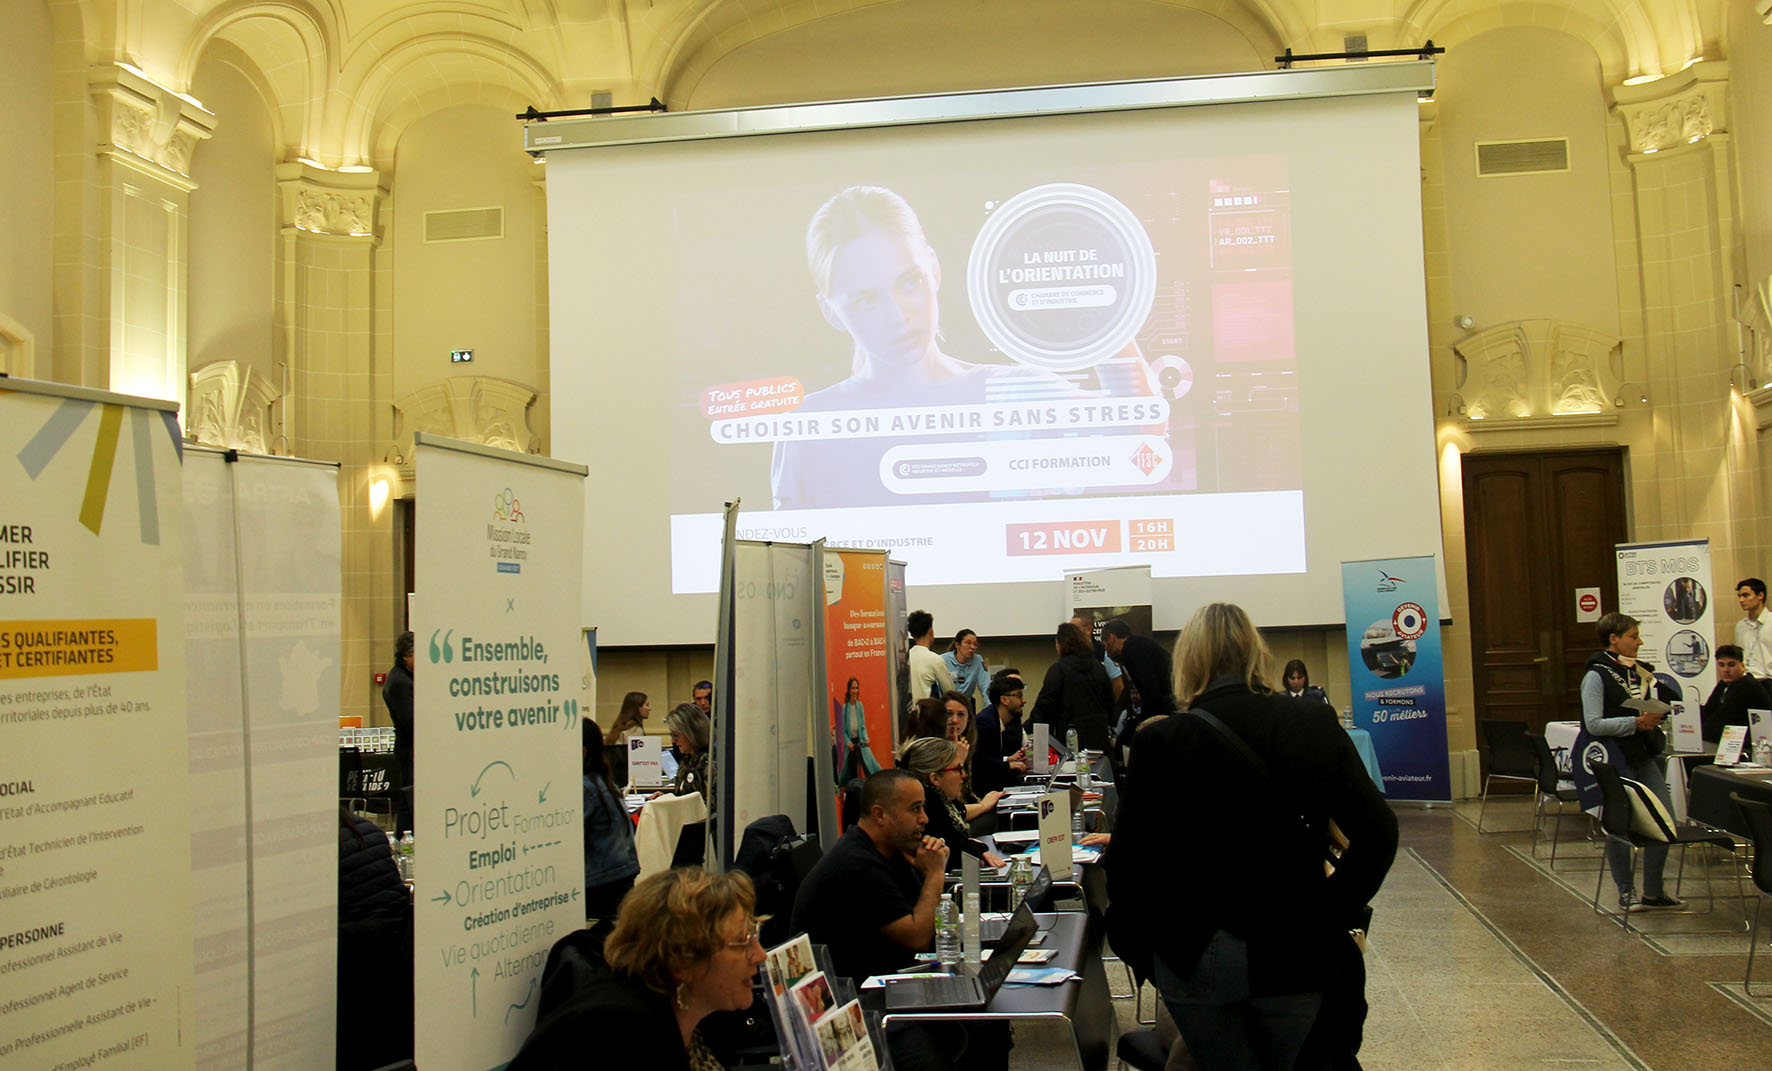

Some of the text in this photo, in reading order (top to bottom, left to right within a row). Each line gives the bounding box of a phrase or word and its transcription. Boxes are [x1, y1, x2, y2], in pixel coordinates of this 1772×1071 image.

[1023, 249, 1097, 265] LA NUIT DE
[999, 263, 1125, 285] L'ORIENTATION
[708, 382, 798, 403] TOUS PUBLICS
[707, 395, 801, 415] ENTRÉE GRATUITE
[720, 403, 1162, 440] CHOISIR SON AVENIR SANS STRESS
[1009, 455, 1111, 470] CCI FORMATION
[1018, 527, 1108, 550] 12 NOV
[1136, 522, 1169, 534] 16H
[851, 539, 863, 549] ET
[865, 537, 934, 548] D'INDUSTRIE
[1137, 538, 1169, 551] 20H
[1625, 556, 1699, 577] BTS MOS
[1397, 602, 1421, 613] DEVENIR
[0, 630, 119, 650] S QUALIFIANTES,
[1397, 628, 1424, 640] AVIATEUR
[16, 649, 114, 668] CERTIFIANTES
[461, 635, 548, 664] Ensemble,
[15, 687, 72, 704] entreprises,
[73, 686, 86, 698] de
[87, 683, 112, 698] l'État
[449, 669, 560, 697] construisons
[1366, 687, 1424, 699] NOUS RECRUTONS
[52, 706, 82, 721] depuis
[84, 703, 104, 718] plus
[106, 702, 119, 714] de
[120, 702, 133, 713] 40
[134, 701, 152, 713] ans.
[455, 699, 560, 731] votre avenir
[1372, 708, 1428, 723] 50 métiers
[0, 780, 36, 797] OCIAL
[26, 795, 97, 817] d'Accompagnant
[444, 800, 577, 840] Projet Formation
[28, 835, 76, 854] Technicien
[76, 833, 88, 846] de
[88, 824, 145, 843] l'Intervention
[468, 841, 517, 870] Emploi
[30, 880, 42, 893] de
[43, 869, 99, 890] Gérontologie
[454, 864, 556, 908] Orientation
[463, 890, 570, 932] Création d'entreprise
[0, 921, 65, 950] PERSONNE
[57, 938, 95, 958] Assistant
[96, 935, 108, 948] de
[109, 931, 124, 944] Vie
[440, 918, 555, 968] Vie quotidienne
[58, 979, 85, 998] Agent
[85, 976, 97, 990] de
[98, 967, 129, 985] Service
[15, 1017, 85, 1051] Professionnelle
[86, 1004, 124, 1025] Assistant
[125, 1001, 137, 1014] de
[138, 997, 152, 1009] Vie
